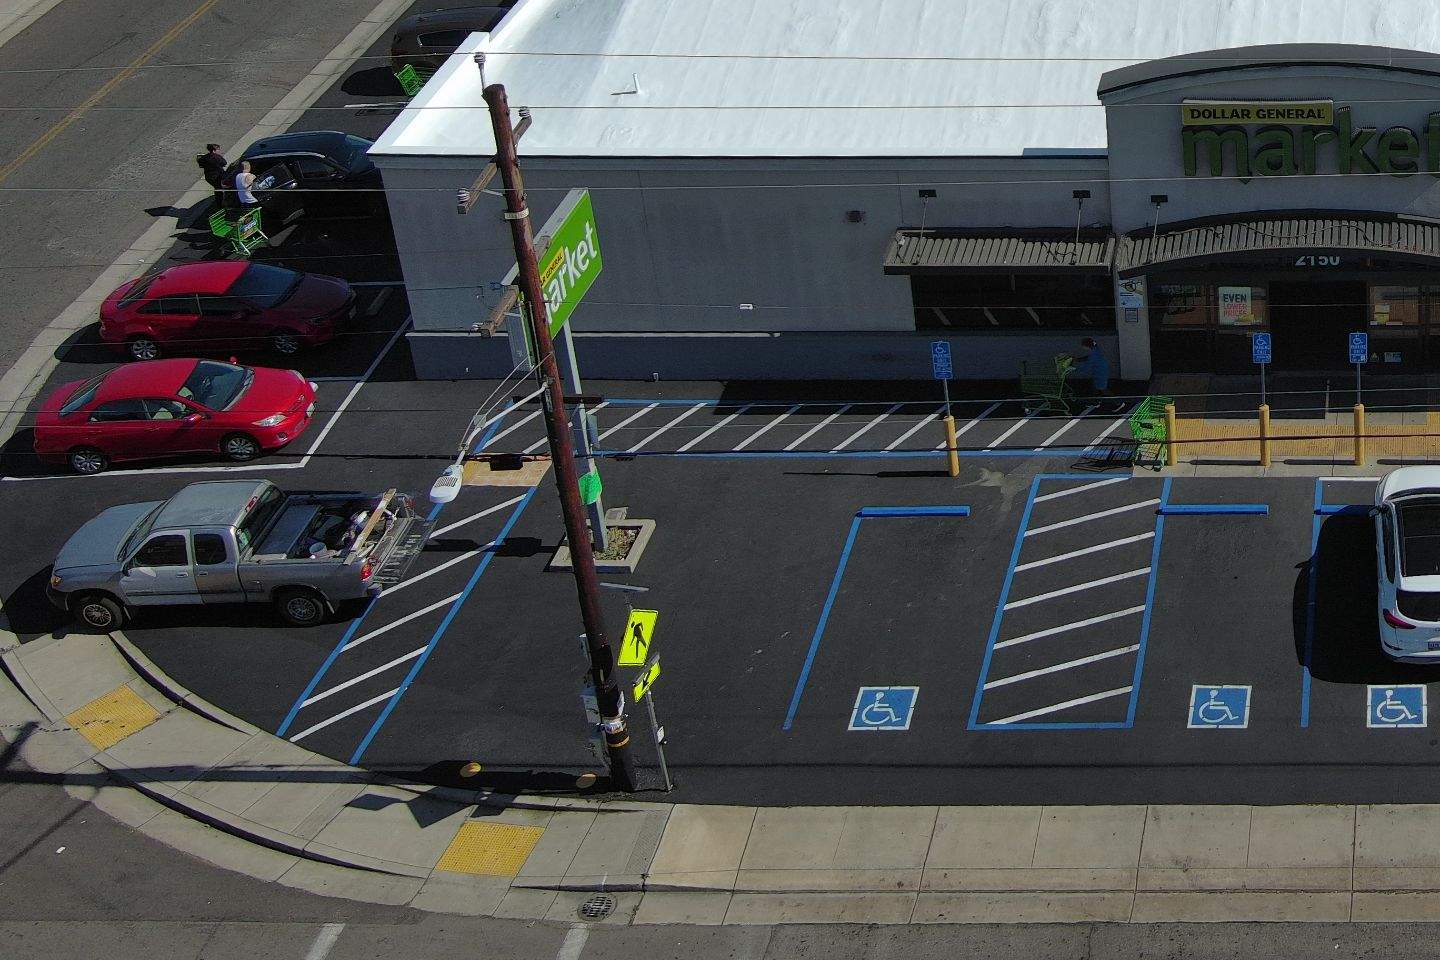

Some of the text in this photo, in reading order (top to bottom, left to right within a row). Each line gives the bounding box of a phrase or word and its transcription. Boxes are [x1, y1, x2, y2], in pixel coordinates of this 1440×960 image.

[1190, 107, 1326, 119] DOLLAR GENERAL
[1295, 255, 1340, 266] 2150
[1223, 293, 1247, 303] EVEN
